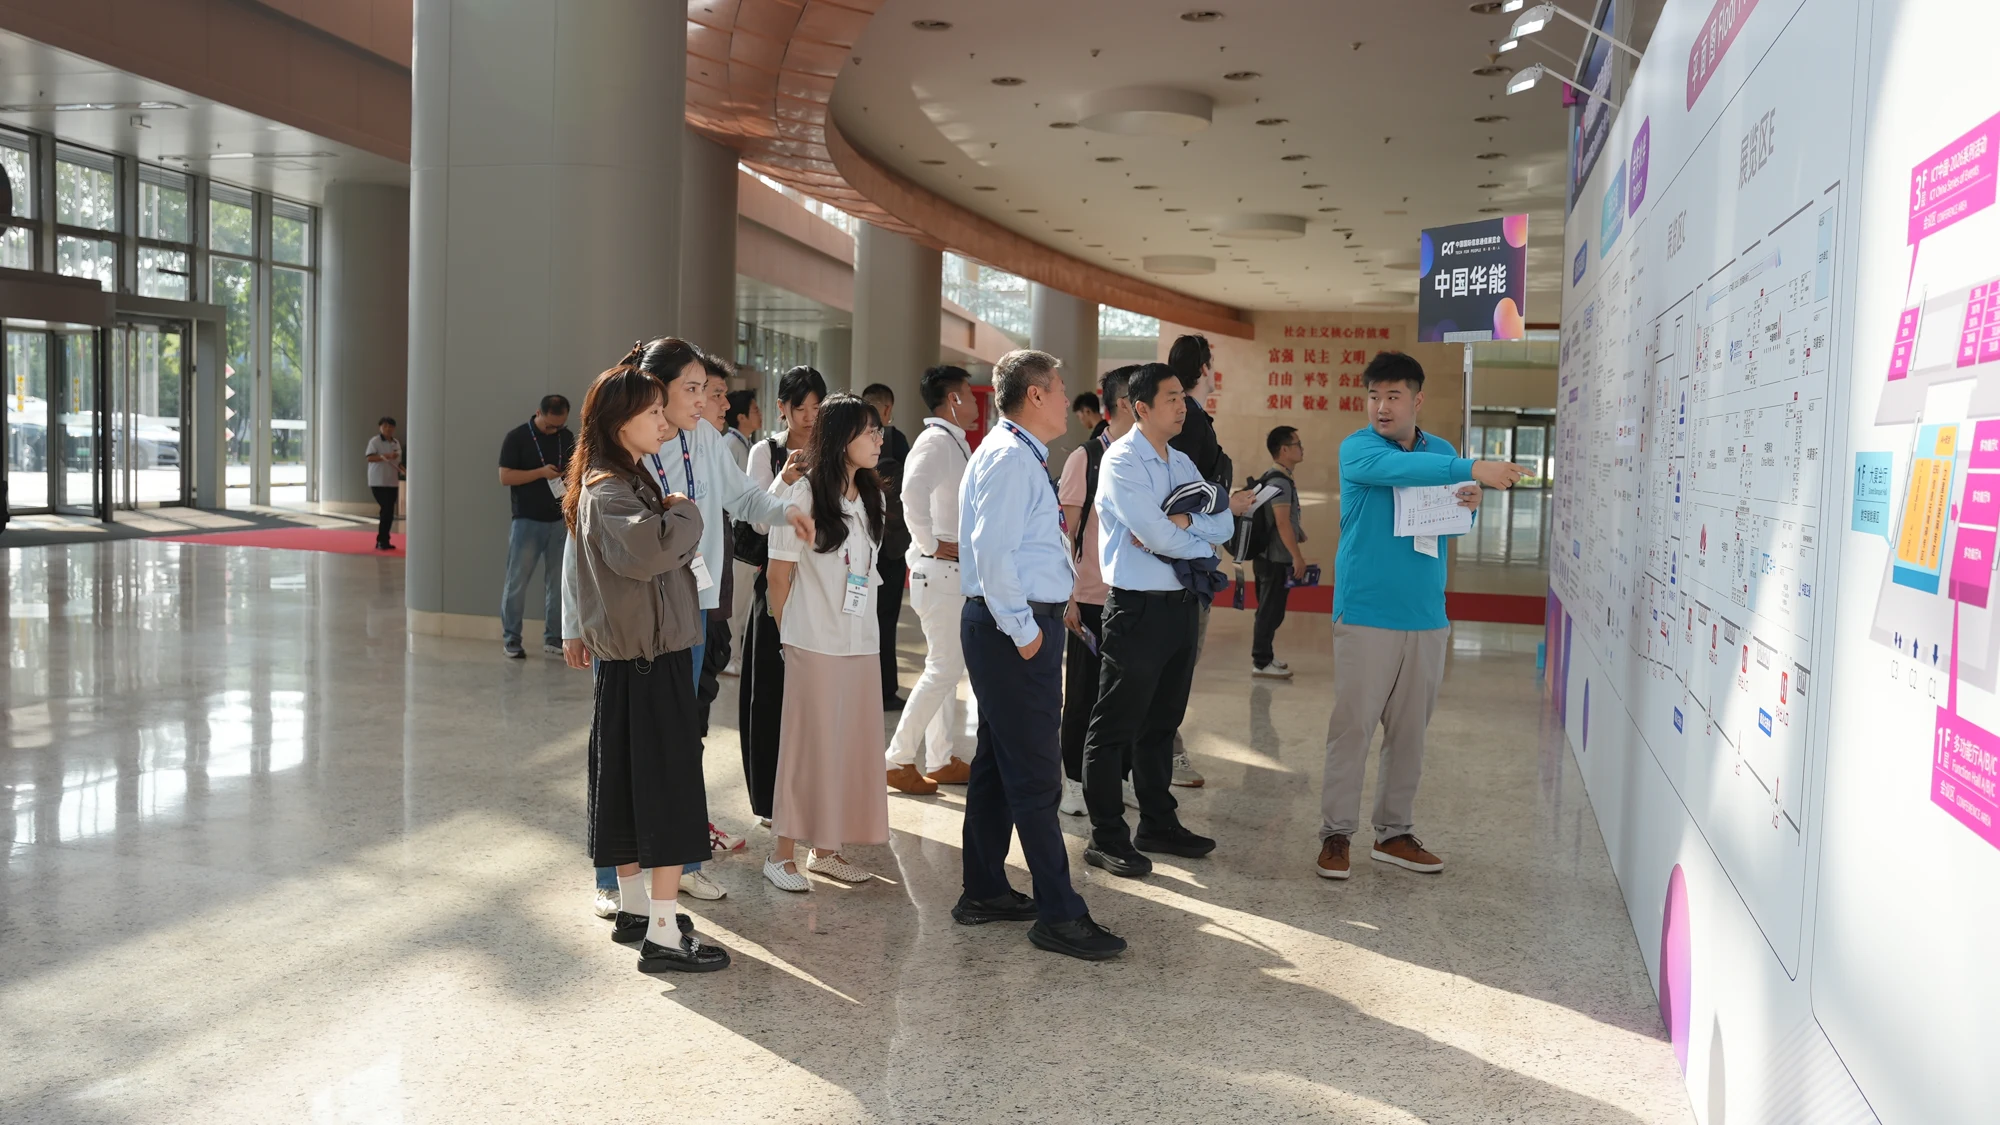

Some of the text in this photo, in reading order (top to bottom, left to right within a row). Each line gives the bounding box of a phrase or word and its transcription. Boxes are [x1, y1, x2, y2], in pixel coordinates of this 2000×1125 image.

[1692, 17, 1717, 92] 平面图
[1738, 107, 1776, 191] 展览区E
[1434, 263, 1507, 298] 中国华能
[1284, 325, 1390, 339] 社会主义核心价值观
[1268, 348, 1294, 364] 富强
[1304, 348, 1330, 364] 民主
[1340, 350, 1366, 365] 文明
[1268, 371, 1364, 388] 自由 平等 公正
[1266, 394, 1365, 412] 爱国 敬业 诚信
